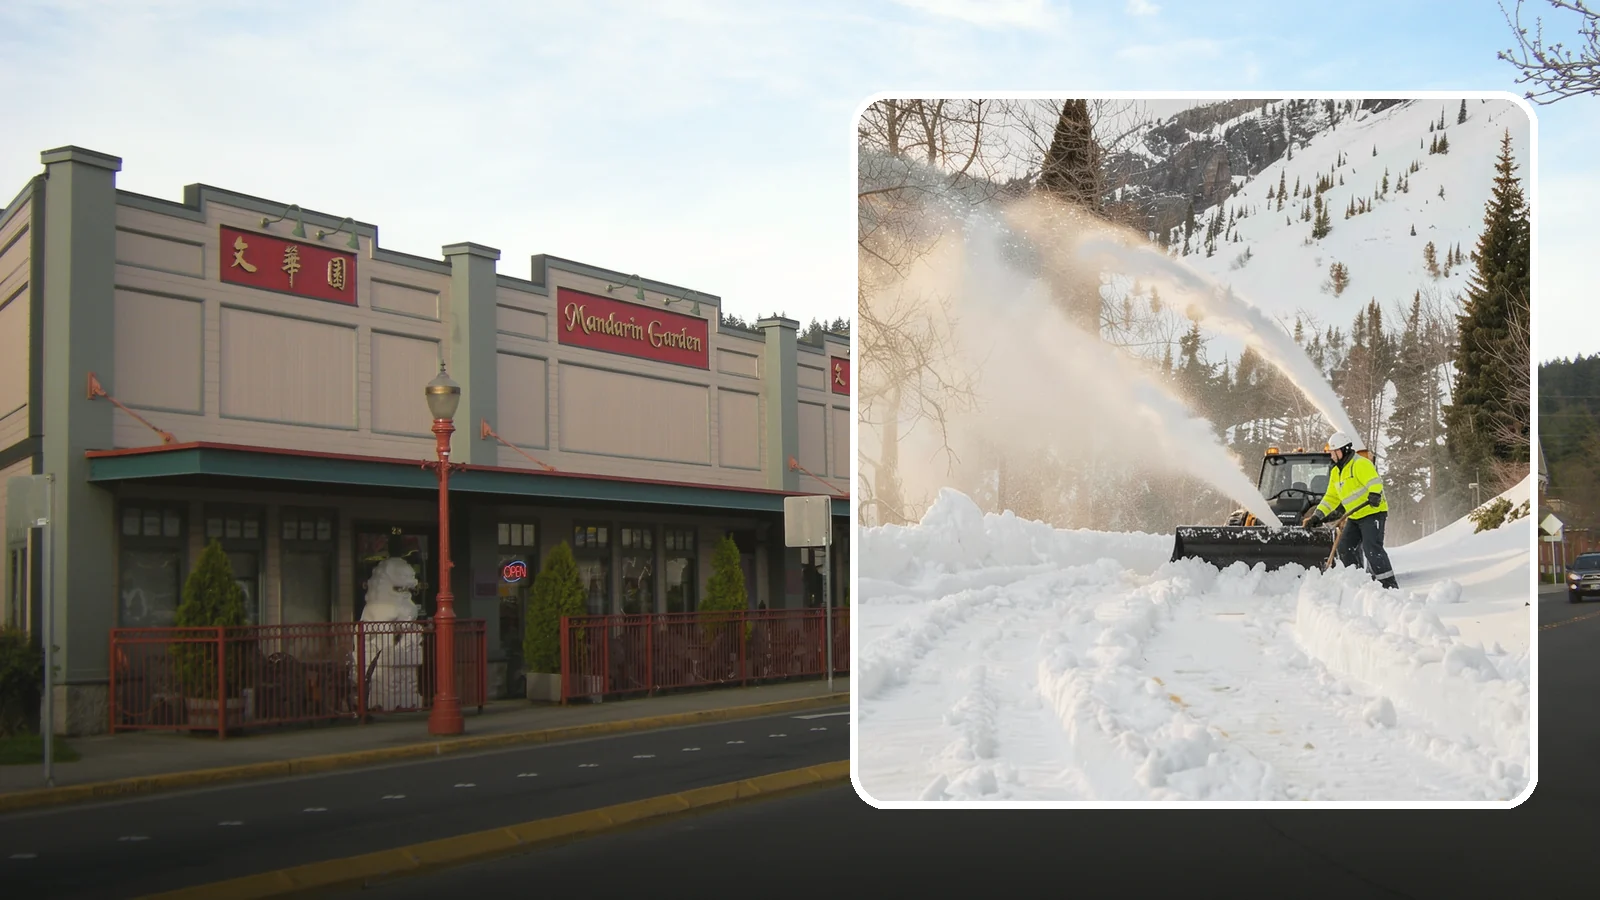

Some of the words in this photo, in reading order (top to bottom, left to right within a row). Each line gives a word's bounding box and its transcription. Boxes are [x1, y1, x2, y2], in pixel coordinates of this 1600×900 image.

[231, 236, 346, 290] 文華園
[564, 302, 644, 341] Mandarin
[647, 320, 702, 352] Garden
[835, 363, 846, 386] 文
[503, 565, 527, 578] OPEN
